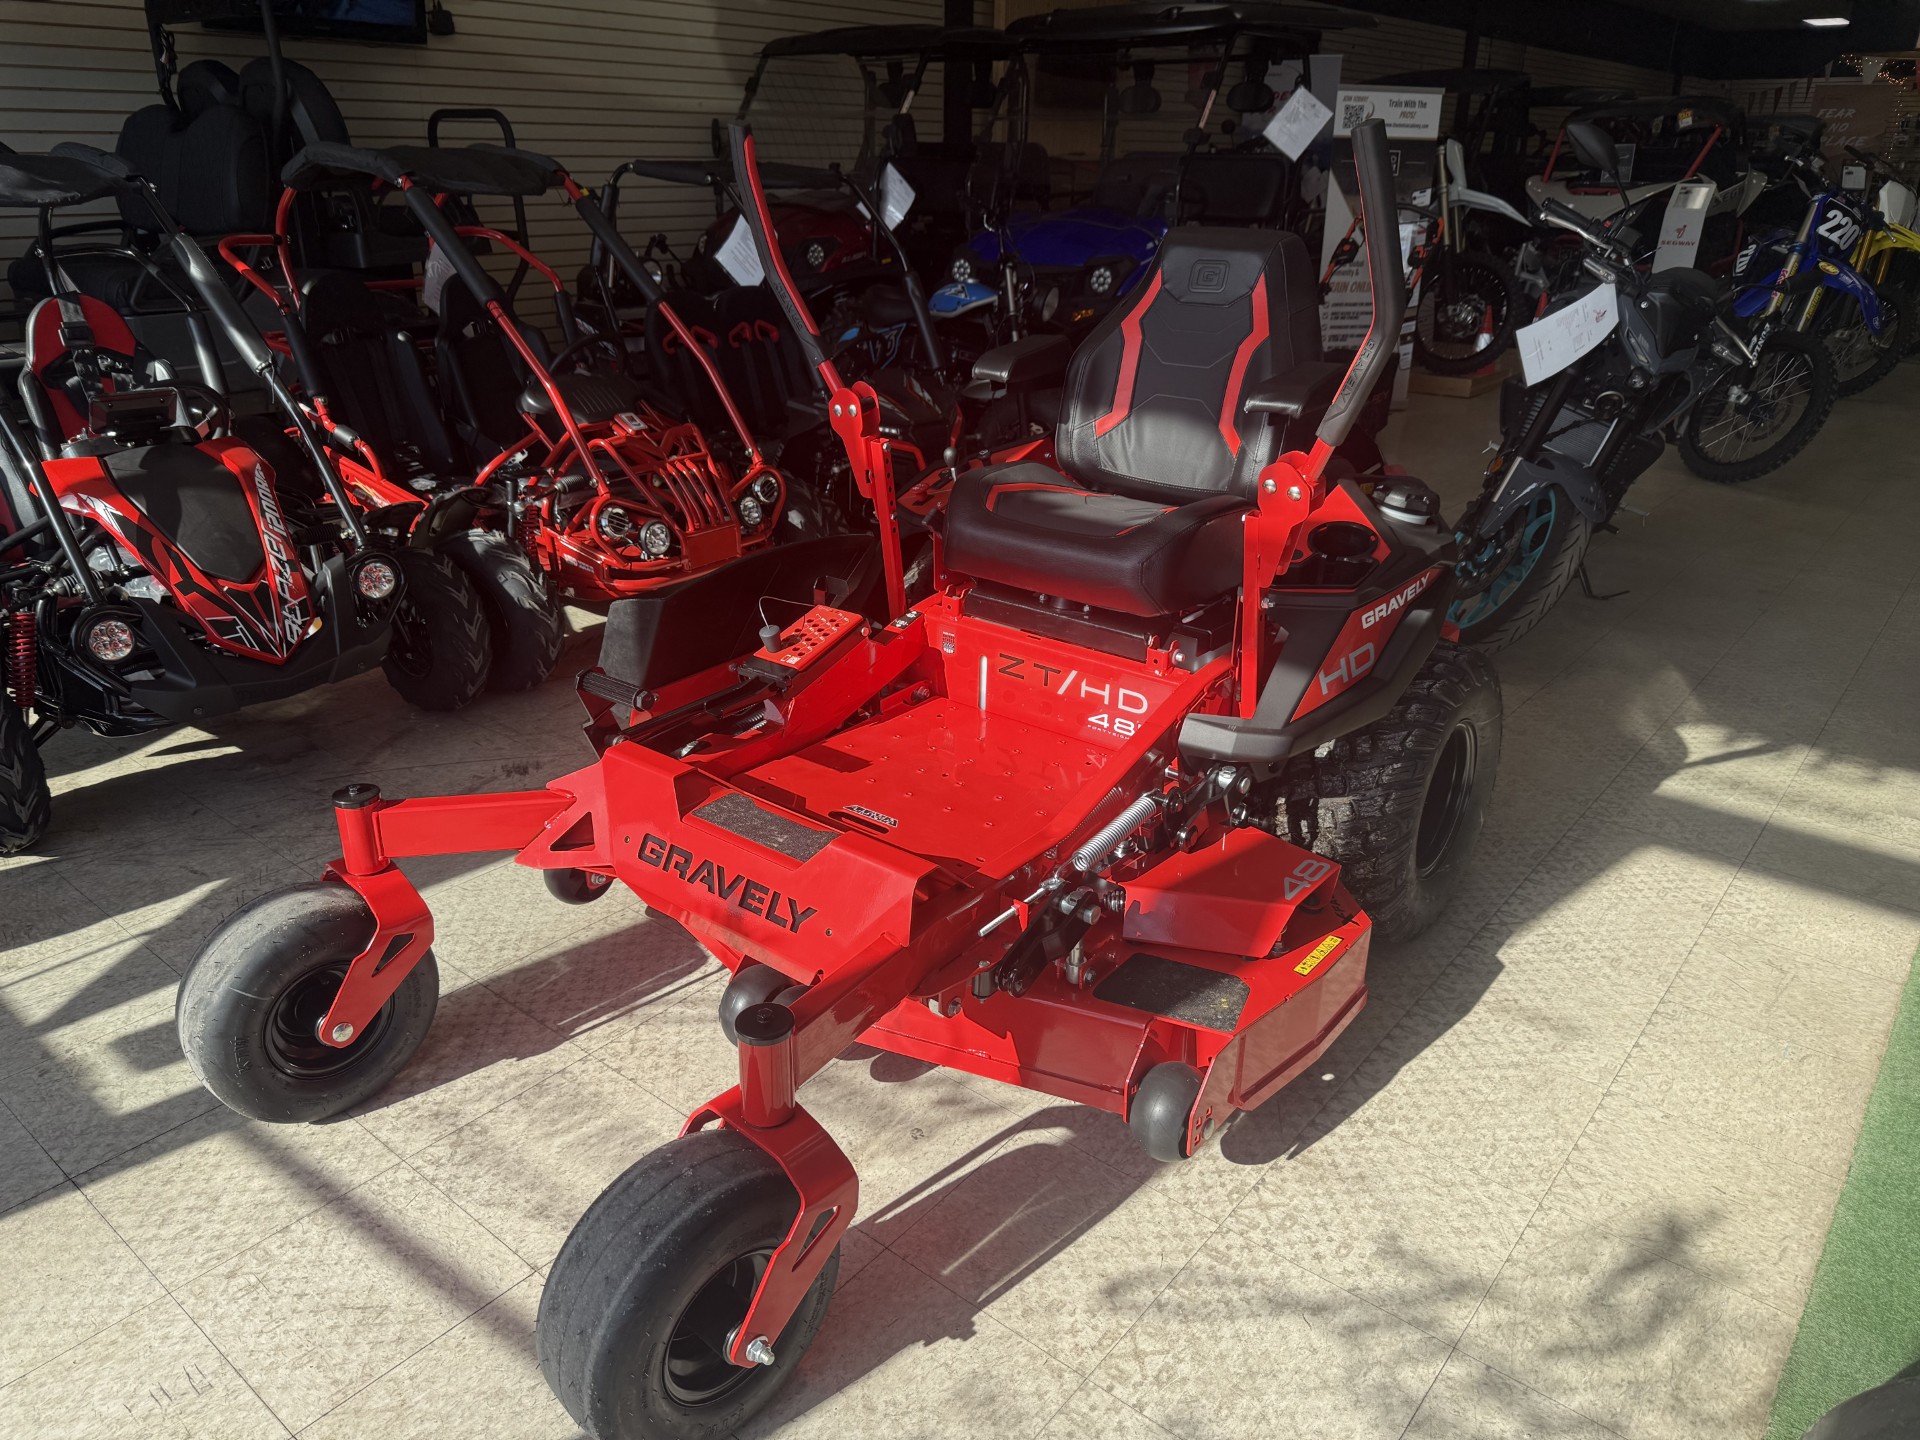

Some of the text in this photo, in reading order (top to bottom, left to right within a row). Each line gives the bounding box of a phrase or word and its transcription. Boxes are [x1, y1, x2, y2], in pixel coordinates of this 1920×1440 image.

[1389, 99, 1427, 109] Train With The
[1816, 107, 1857, 119] FEAR
[1826, 122, 1849, 133] NO
[1816, 209, 1861, 251] 220
[1361, 572, 1431, 630] GRAVELY
[998, 652, 1149, 715] ZT/HD
[1318, 642, 1376, 696] HD
[1087, 724, 1131, 741] FORTYEIGH
[637, 832, 818, 933] GRAVELY
[1284, 859, 1331, 901] 48
